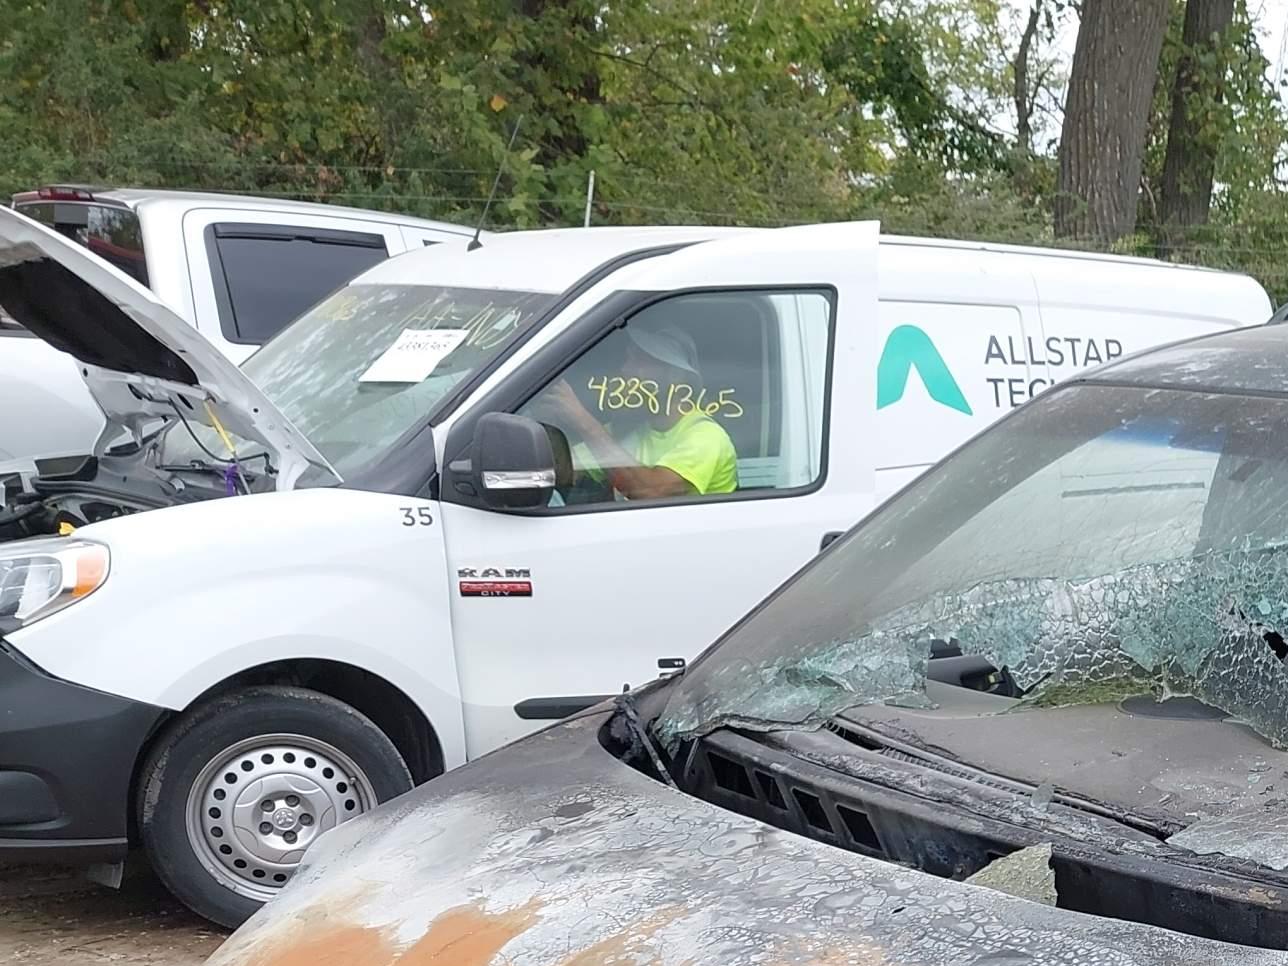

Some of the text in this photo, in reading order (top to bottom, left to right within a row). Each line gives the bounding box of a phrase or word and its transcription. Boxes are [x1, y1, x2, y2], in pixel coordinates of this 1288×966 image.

[587, 375, 744, 418] 43381365
[400, 506, 434, 527] 35
[457, 567, 531, 578] RAM
